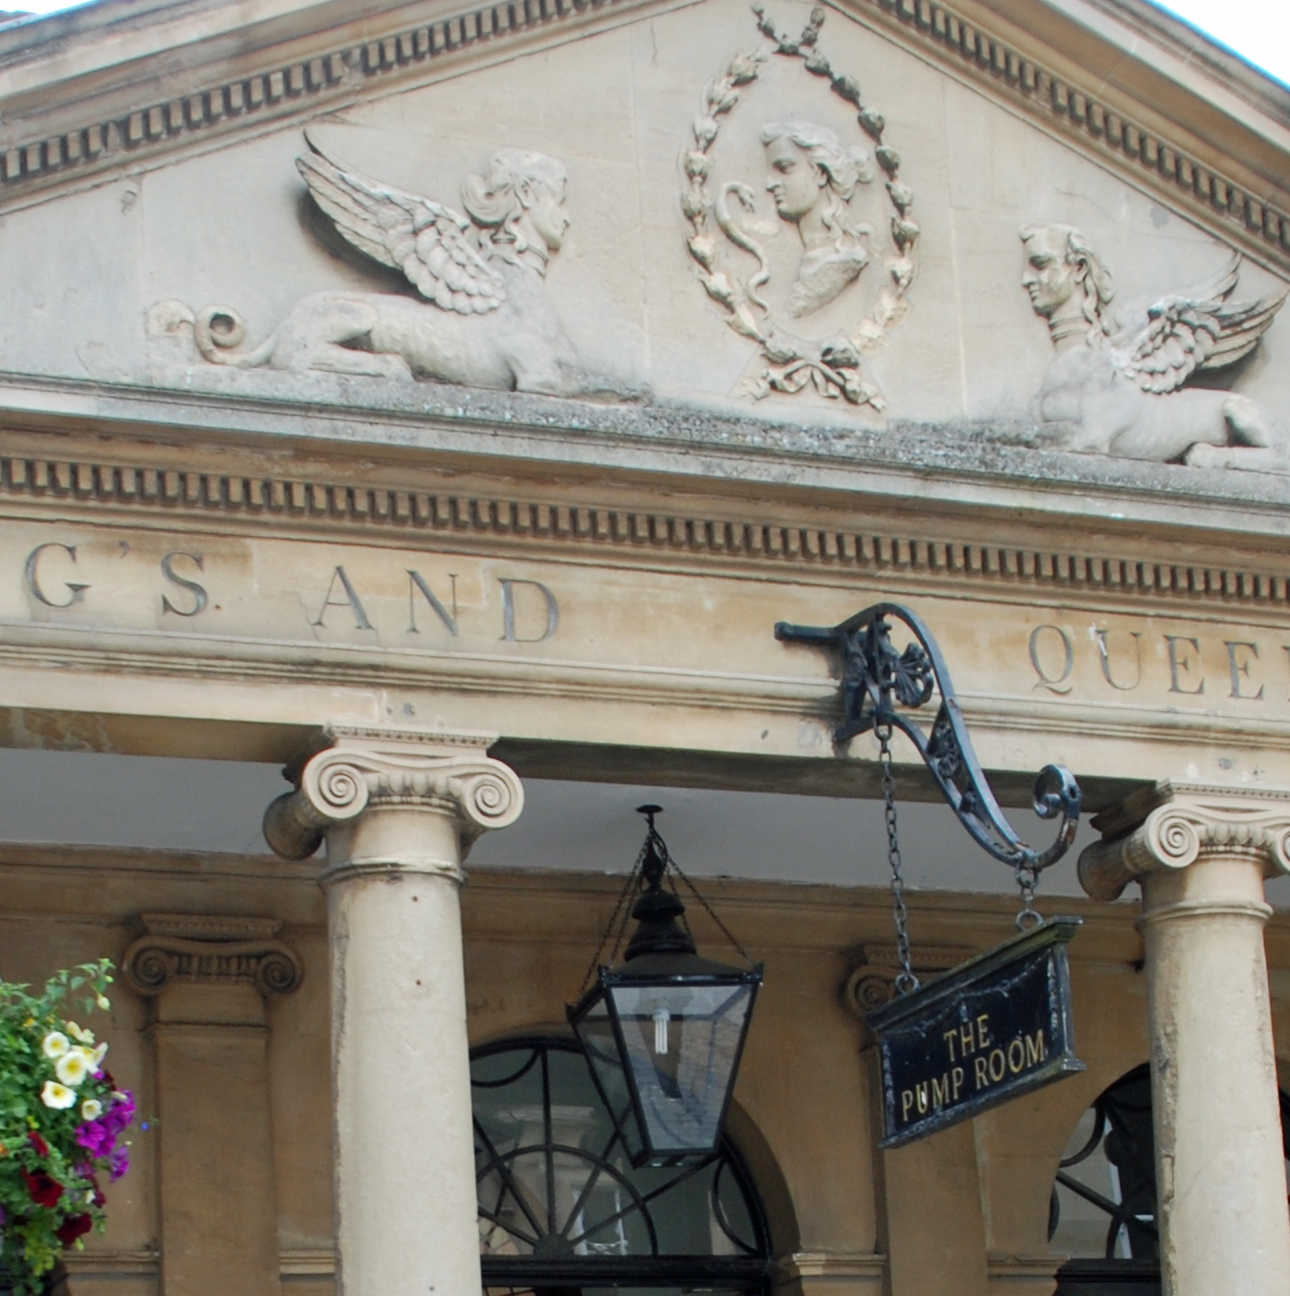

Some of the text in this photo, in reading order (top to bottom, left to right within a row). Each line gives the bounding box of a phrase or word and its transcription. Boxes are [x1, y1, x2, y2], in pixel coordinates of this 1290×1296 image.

[312, 564, 561, 644] AND
[901, 1029, 1045, 1122] PUMP ROOM
[943, 1014, 991, 1062] THE
